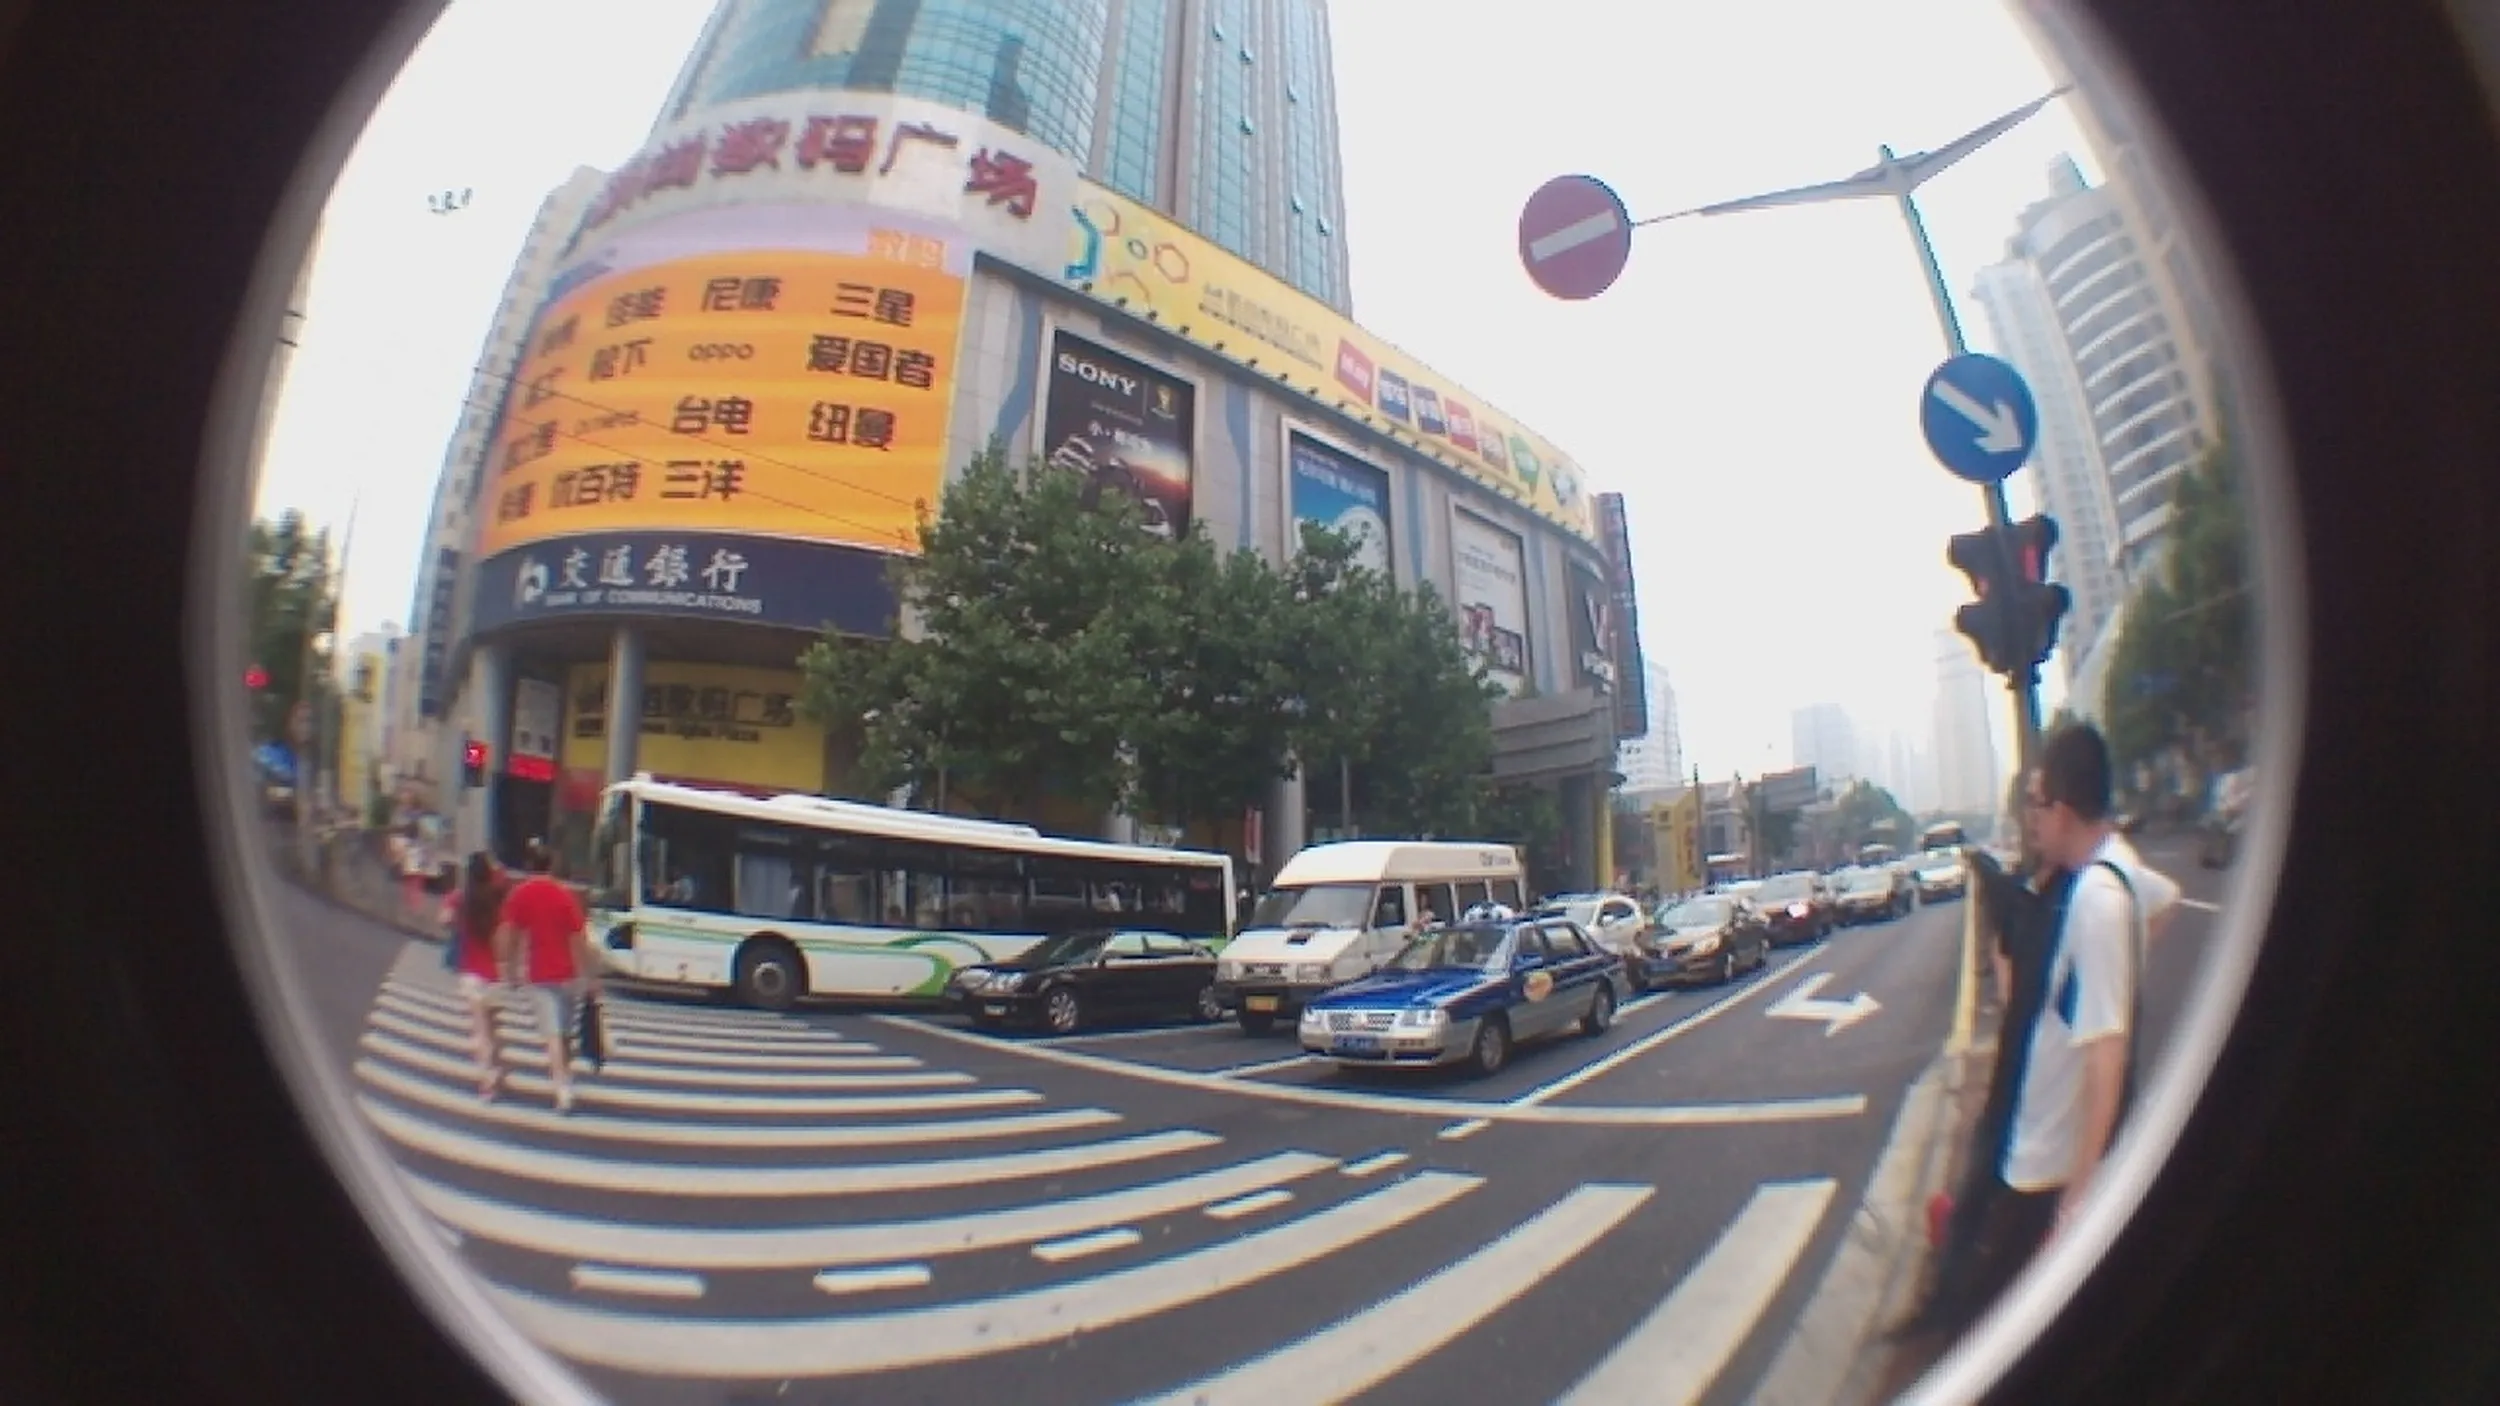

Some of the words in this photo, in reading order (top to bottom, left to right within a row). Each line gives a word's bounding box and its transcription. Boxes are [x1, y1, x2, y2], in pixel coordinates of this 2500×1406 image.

[702, 276, 783, 312] 尼康
[830, 282, 915, 327] 三星
[806, 333, 935, 390] 爱国者
[1058, 352, 1137, 396] SONY
[673, 395, 752, 434] 台电
[807, 400, 895, 451] 纽曼
[660, 460, 745, 501] 三洋
